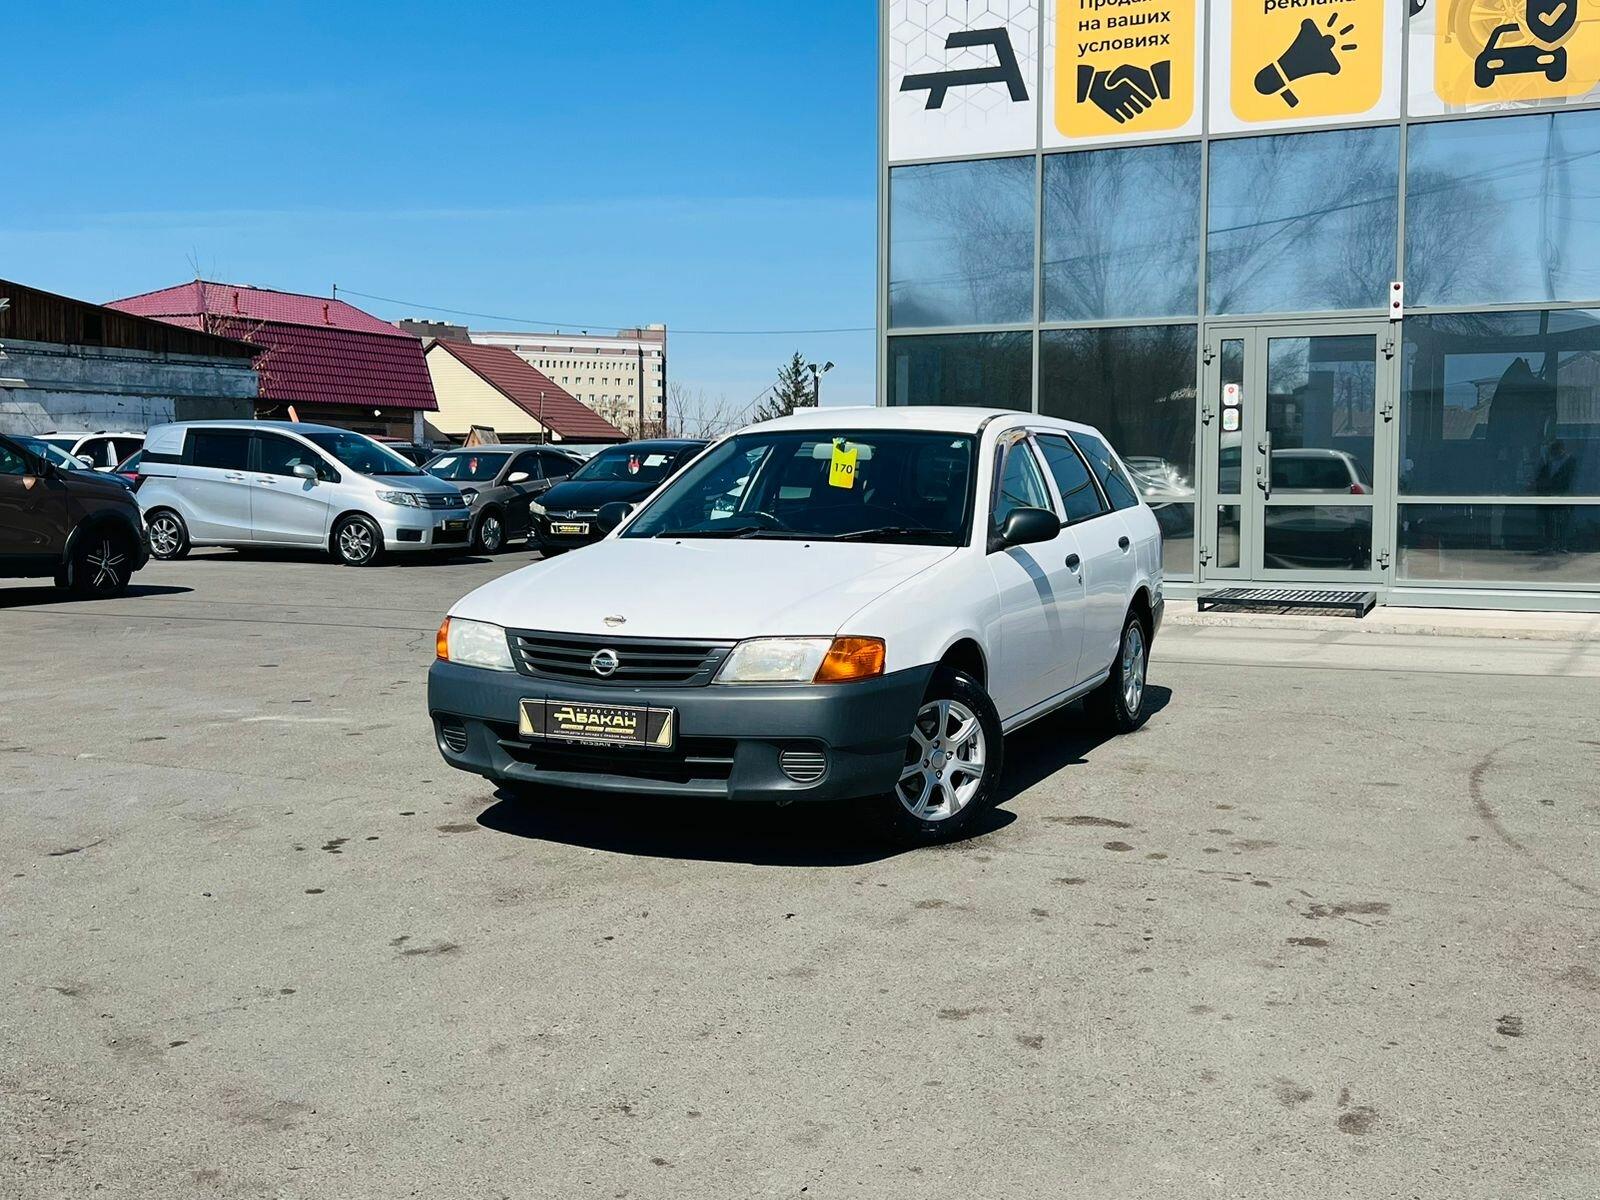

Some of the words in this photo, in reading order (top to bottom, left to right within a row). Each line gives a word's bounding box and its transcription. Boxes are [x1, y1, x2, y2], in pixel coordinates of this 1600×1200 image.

[1264, 0, 1356, 14] рекл
[1078, 18, 1101, 32] на
[1107, 10, 1171, 29] ваших
[1077, 33, 1170, 58] условиях
[835, 462, 853, 474] 170
